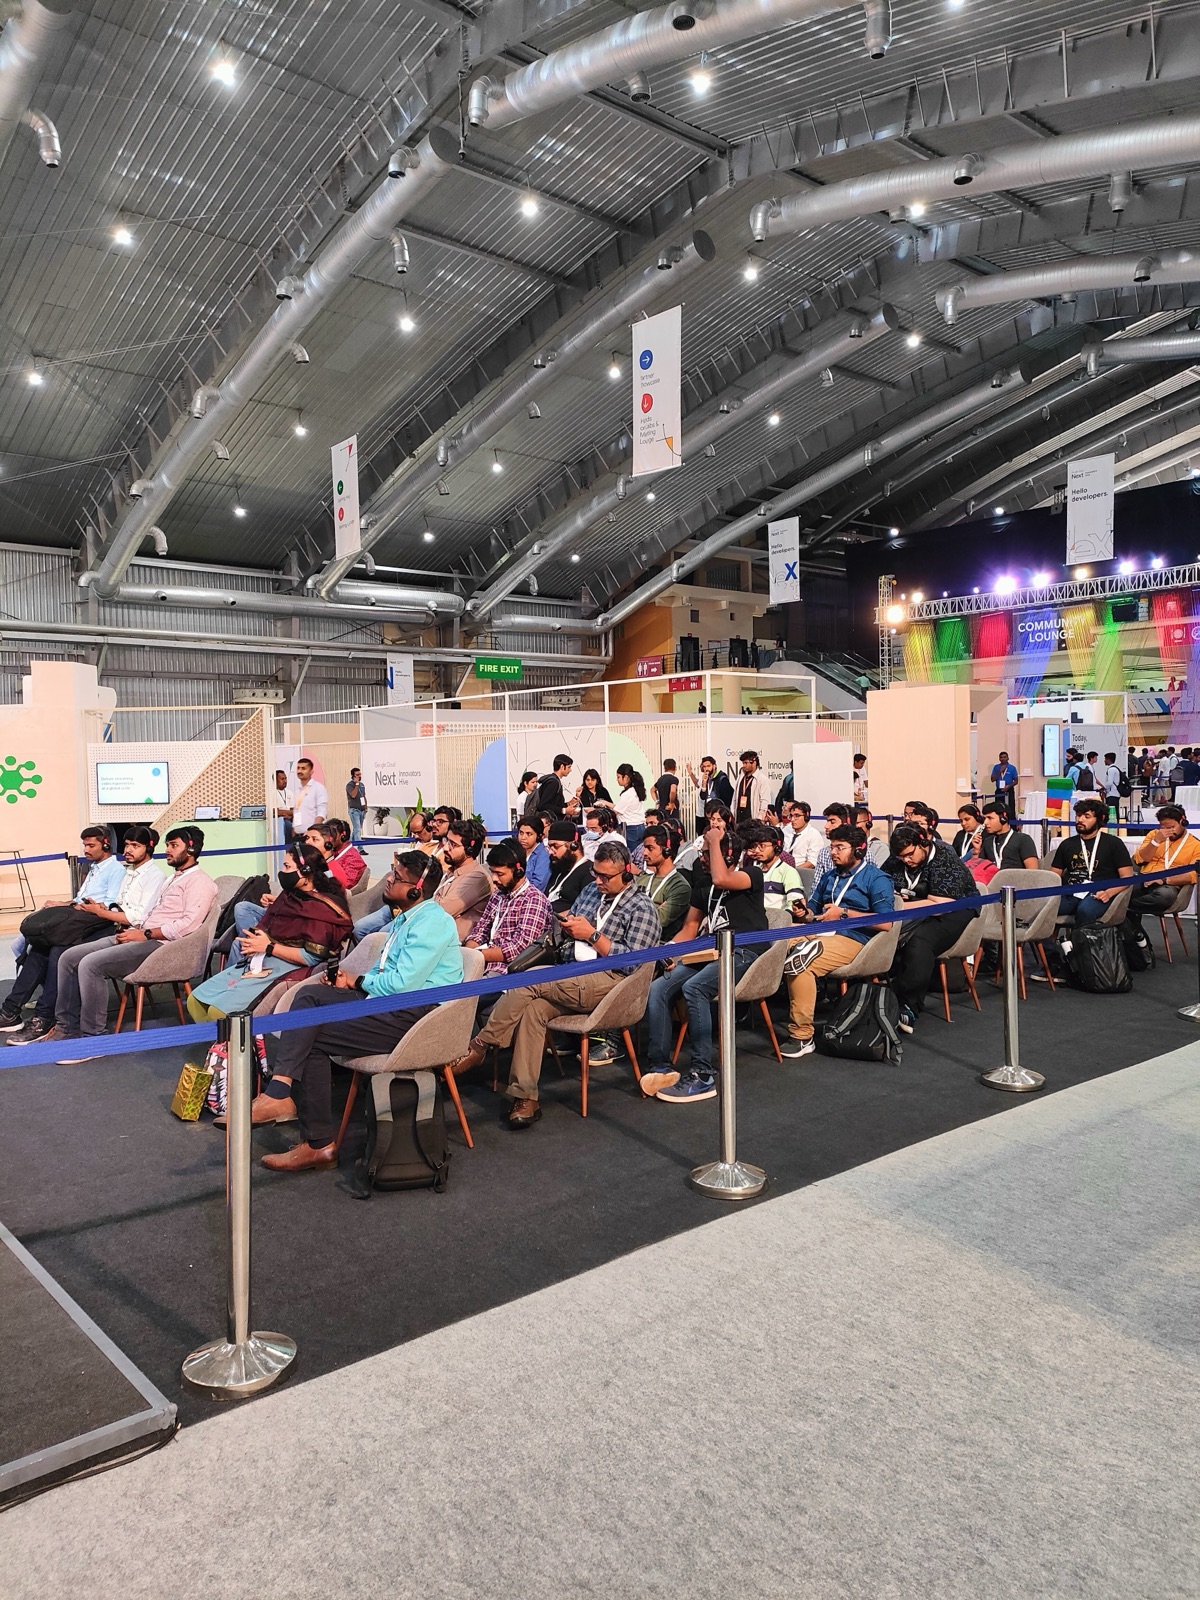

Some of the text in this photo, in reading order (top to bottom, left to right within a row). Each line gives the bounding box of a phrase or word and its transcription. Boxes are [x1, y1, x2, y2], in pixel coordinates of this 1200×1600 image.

[1071, 488, 1088, 496] Hello
[1071, 491, 1109, 503] developers.
[1029, 629, 1075, 643] LOUNGE
[479, 664, 519, 674] FIRE EXIT
[375, 771, 397, 786] Next
[767, 771, 783, 781] Hive
